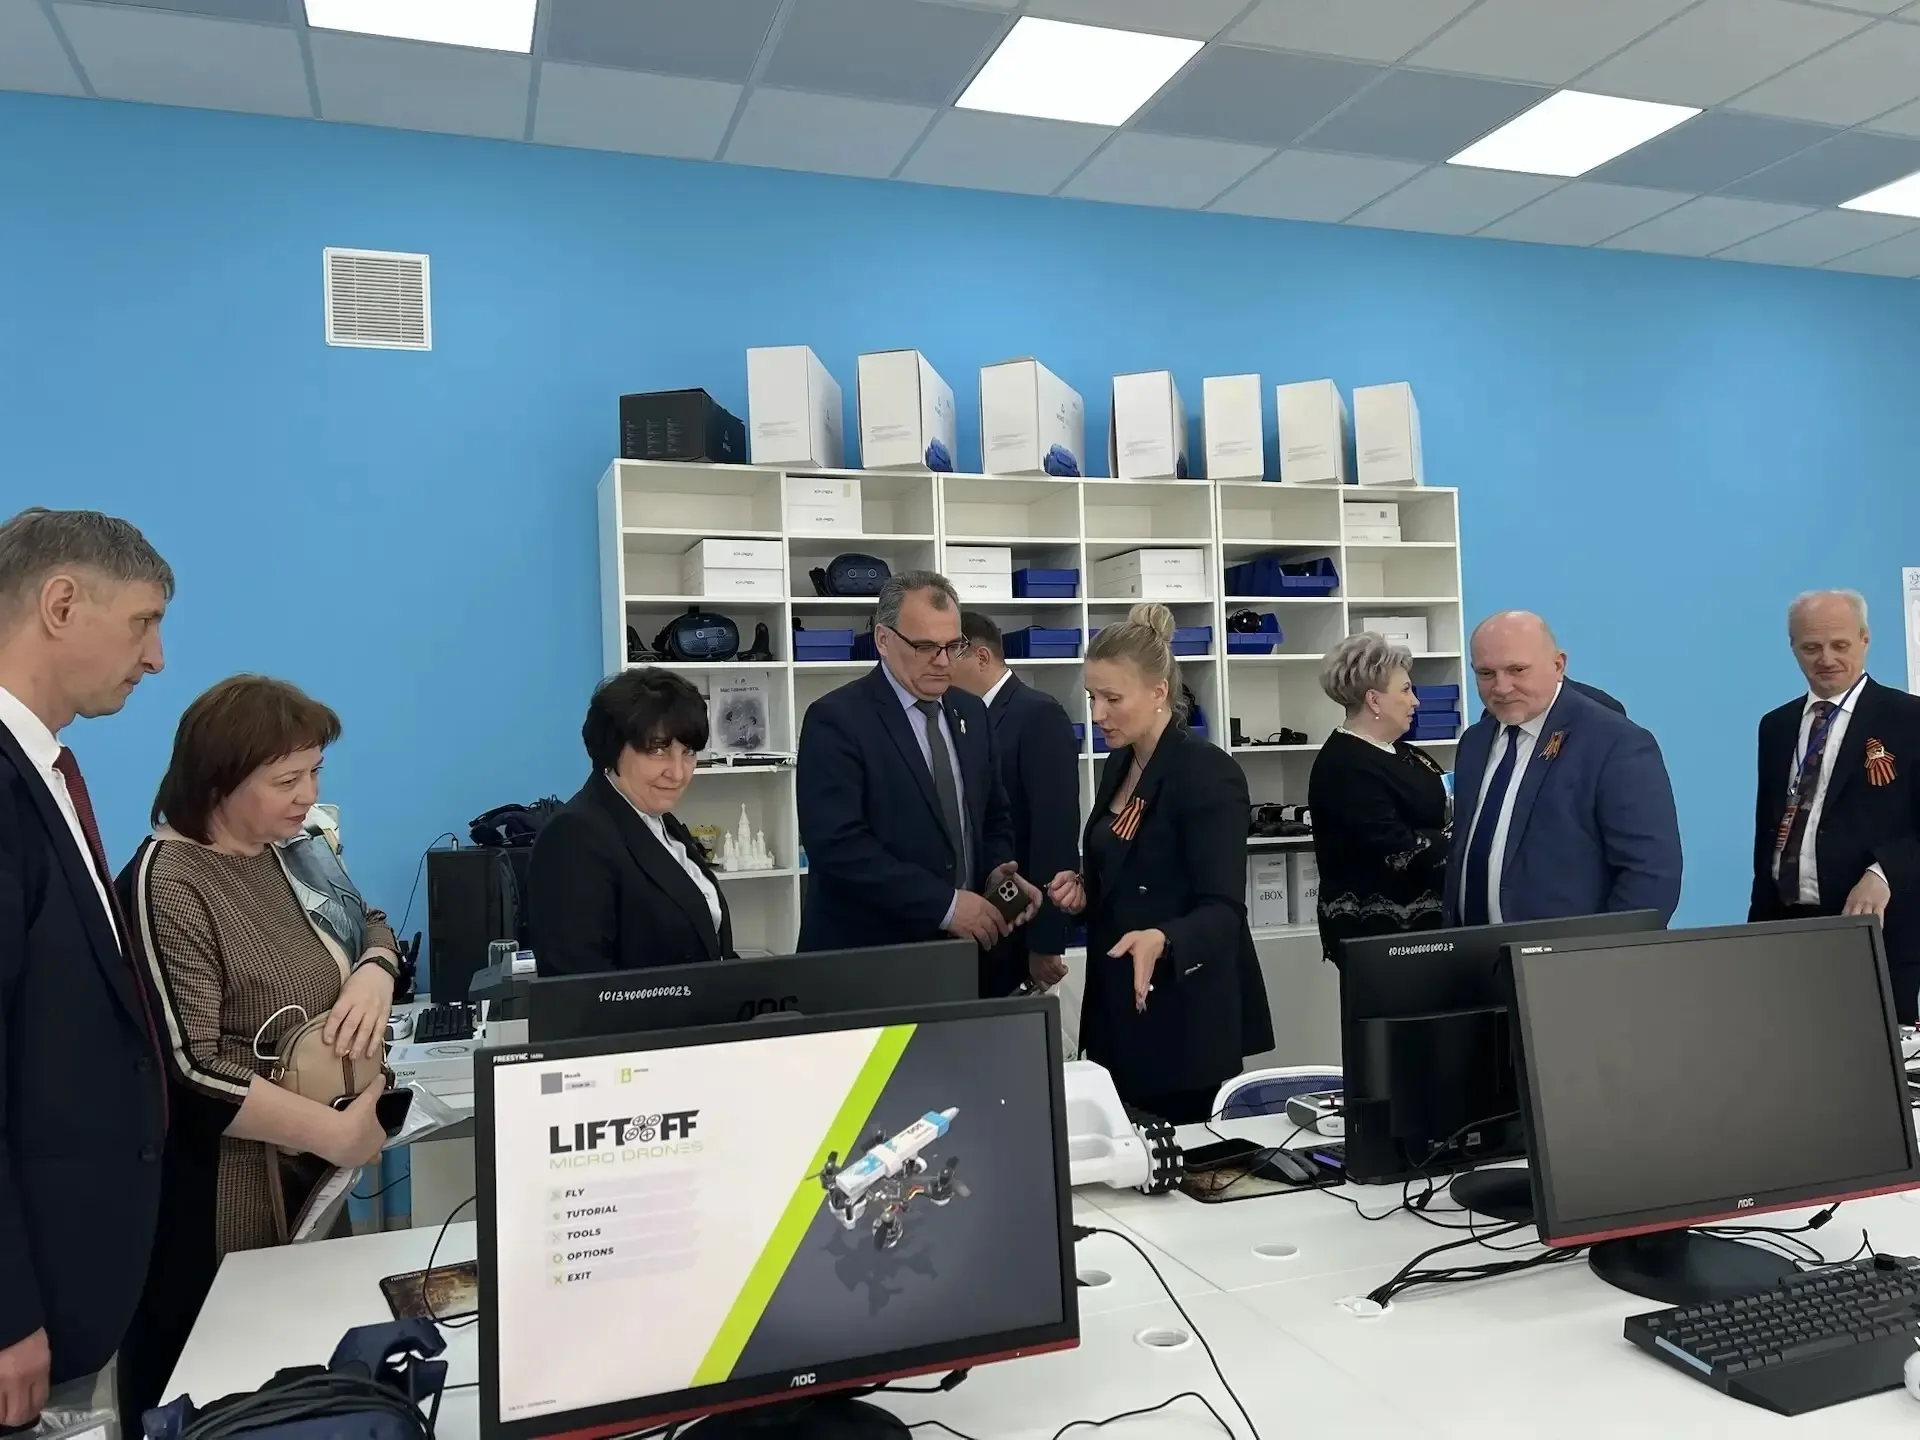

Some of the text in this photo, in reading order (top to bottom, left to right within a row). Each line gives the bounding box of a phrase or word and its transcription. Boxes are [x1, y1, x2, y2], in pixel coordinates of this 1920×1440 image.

[1260, 890, 1283, 901] eBOX
[1304, 888, 1319, 898] eBO
[492, 1053, 529, 1063] FREESYNC
[549, 1140, 705, 1170] MICRO DRONES
[565, 1188, 585, 1198] FLY
[1737, 1197, 1754, 1209] AOC
[566, 1205, 618, 1219] TUTORIAL
[567, 1228, 601, 1240] TOOLS
[567, 1247, 614, 1261] OPTIONS
[567, 1271, 592, 1282] EXIT
[790, 1372, 816, 1388] AOC
